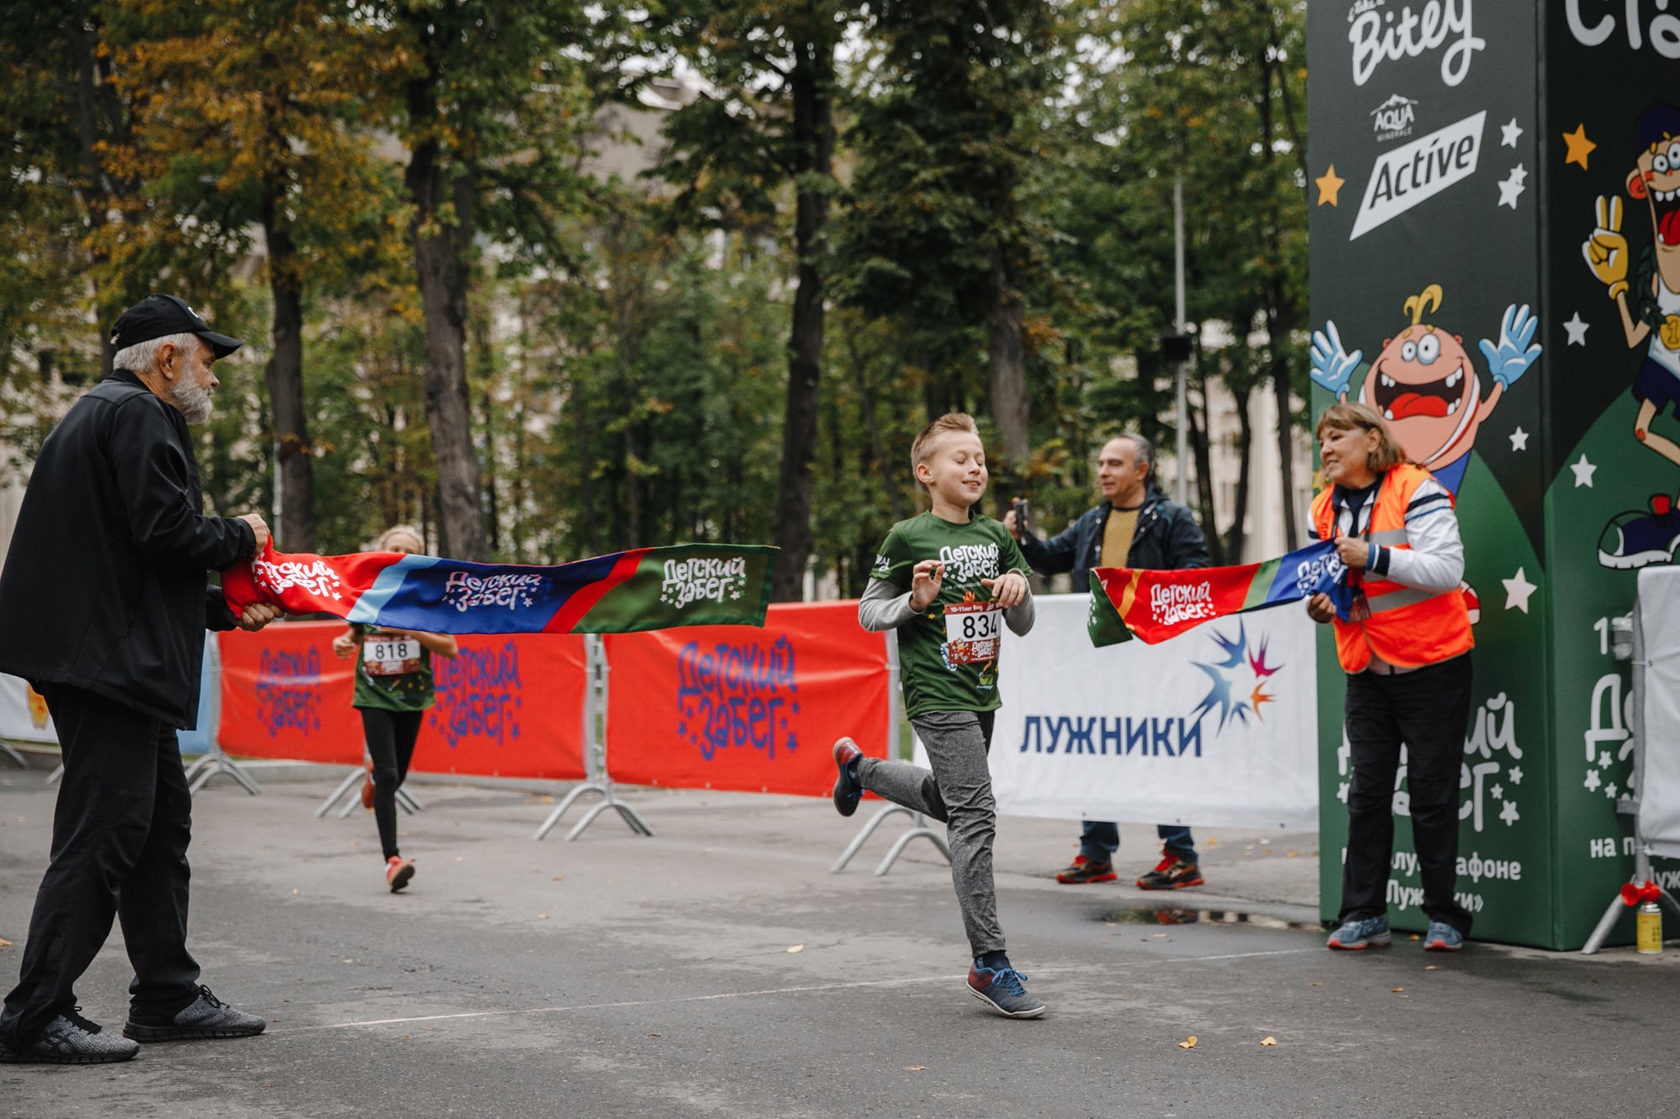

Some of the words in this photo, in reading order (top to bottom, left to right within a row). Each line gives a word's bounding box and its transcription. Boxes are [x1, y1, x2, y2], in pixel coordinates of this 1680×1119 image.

[1348, 0, 1486, 87] Bitey
[1373, 103, 1415, 132] AQUA
[445, 571, 542, 593] Детский
[662, 556, 746, 592] Детский
[1151, 581, 1212, 612] Детский
[963, 612, 997, 638] 834
[375, 642, 408, 659] 818
[677, 634, 798, 712] Детский
[1019, 715, 1202, 758] ЛУЖНИКИ
[1589, 838, 1616, 858] на
